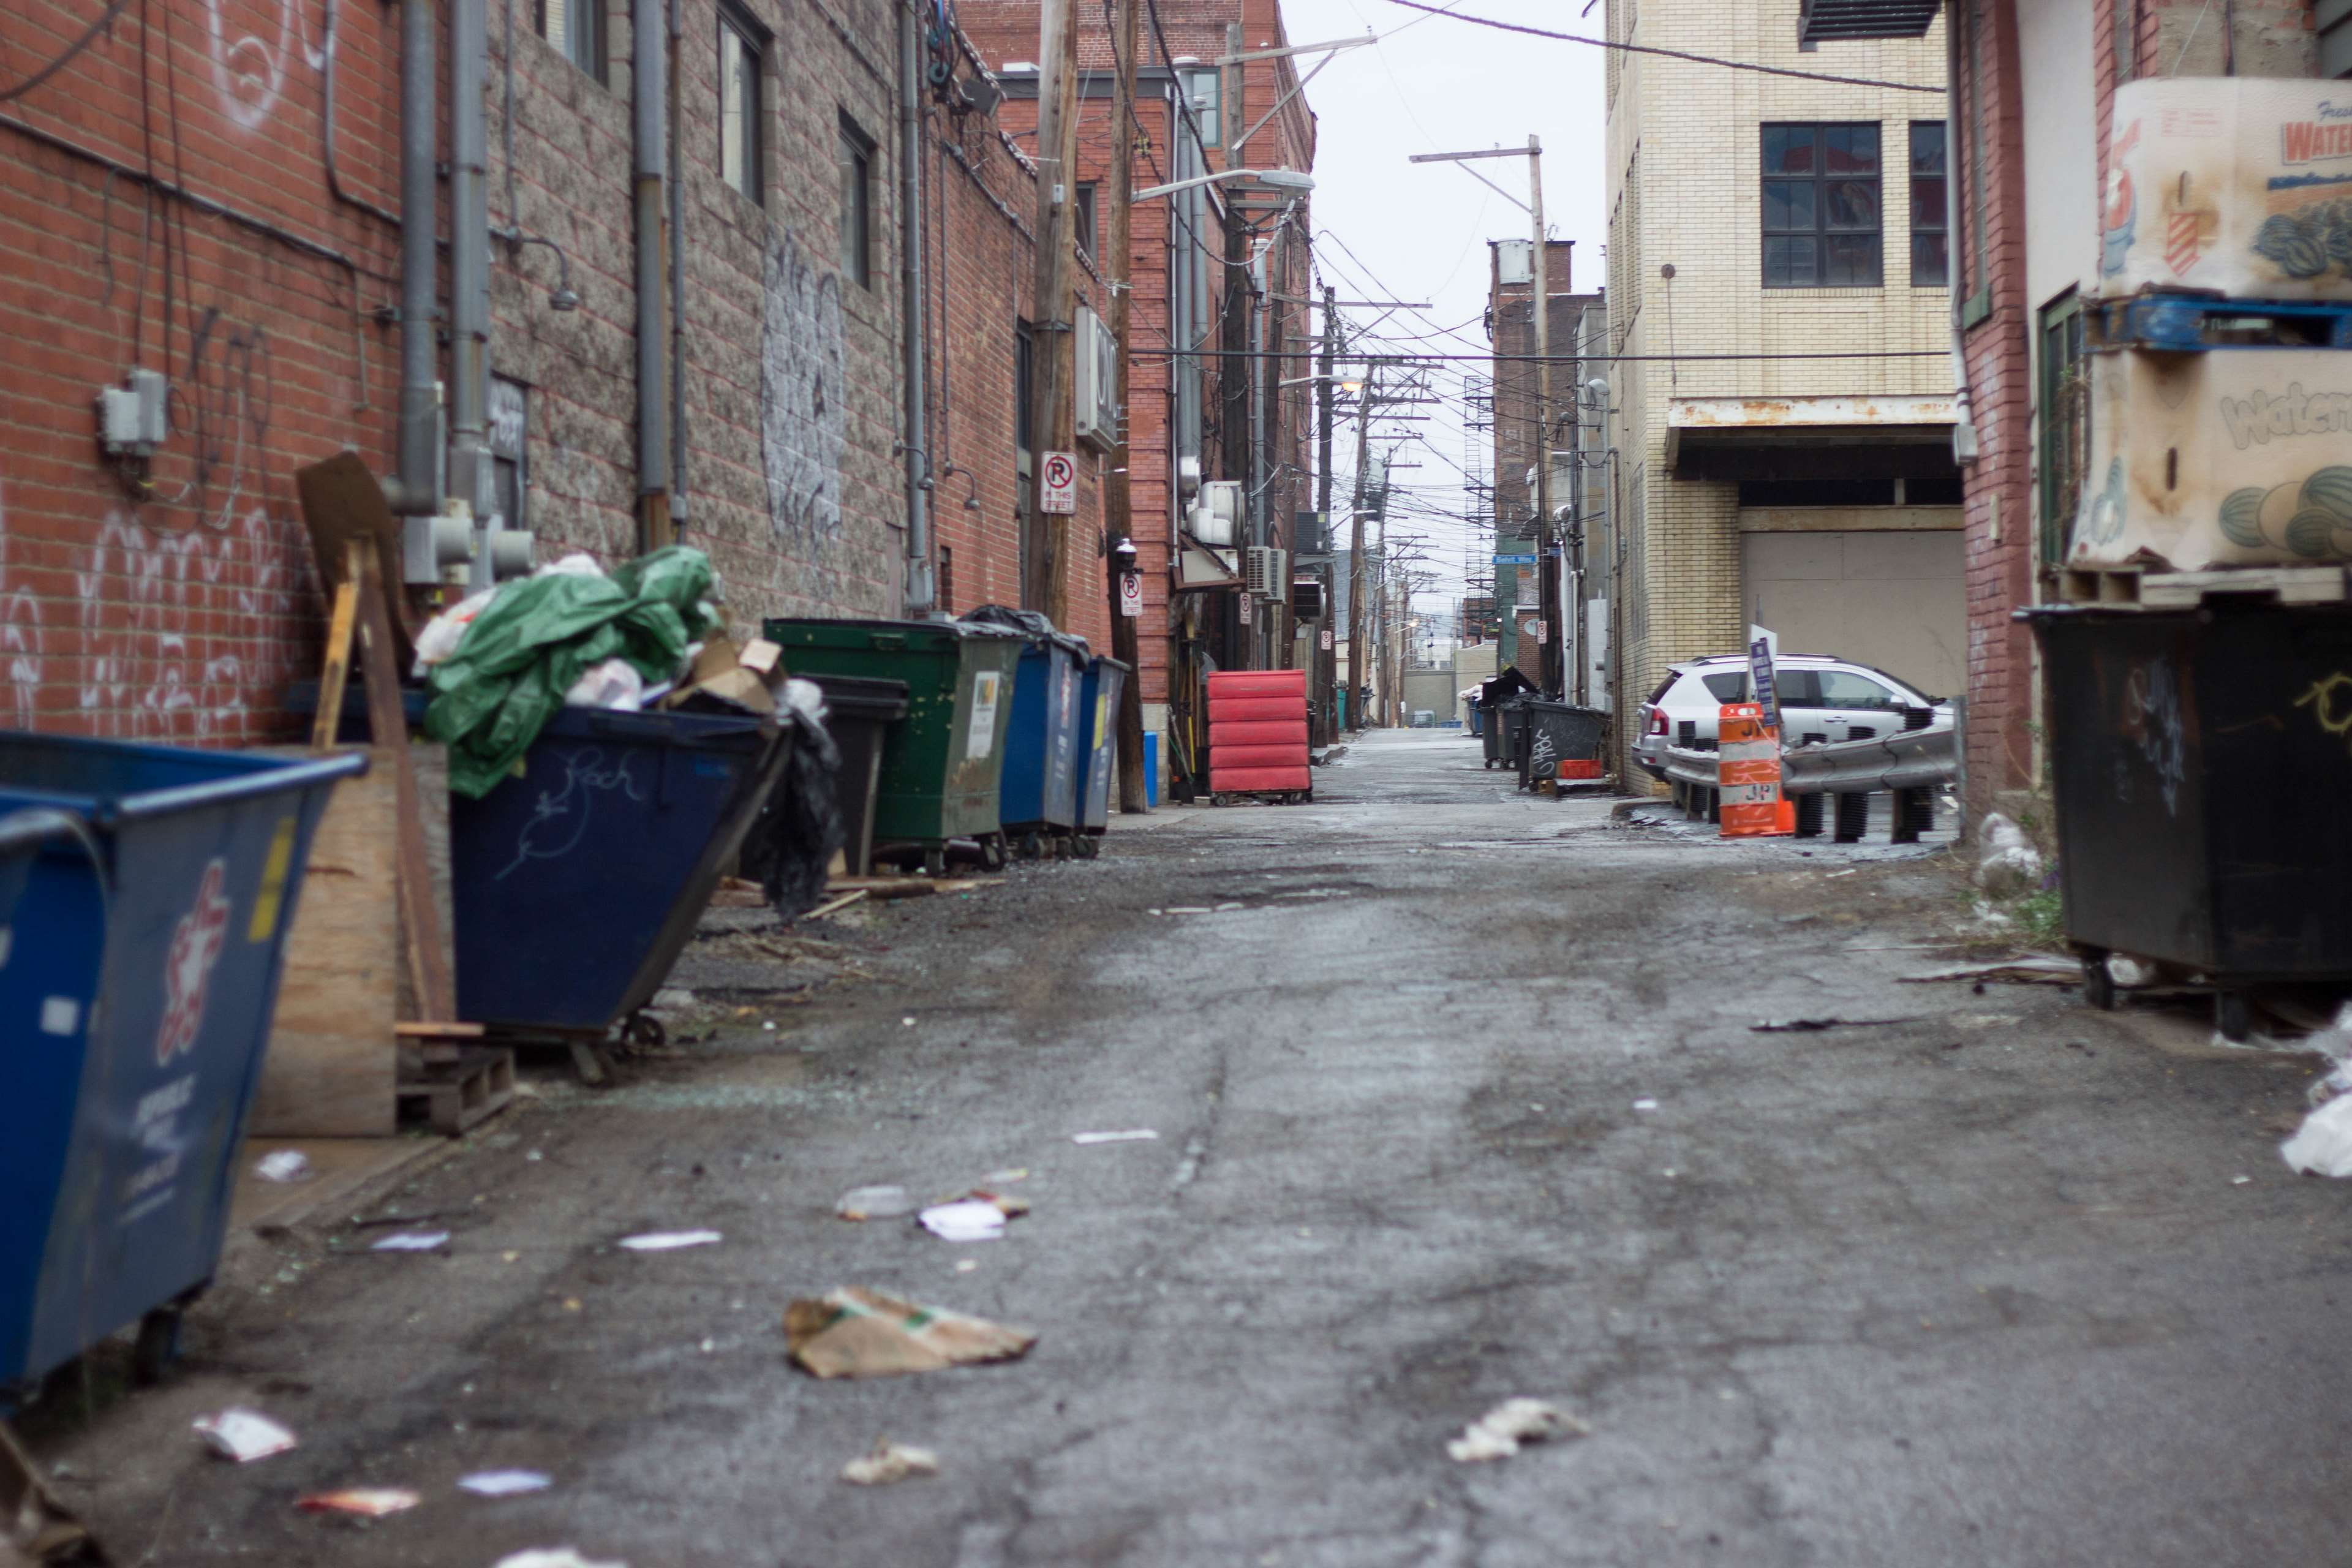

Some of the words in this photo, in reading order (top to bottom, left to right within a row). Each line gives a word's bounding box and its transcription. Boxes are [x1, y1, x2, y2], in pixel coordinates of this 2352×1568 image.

[2316, 100, 2352, 122] Fres
[2220, 381, 2352, 450] Water
[1055, 491, 1072, 500] THIS
